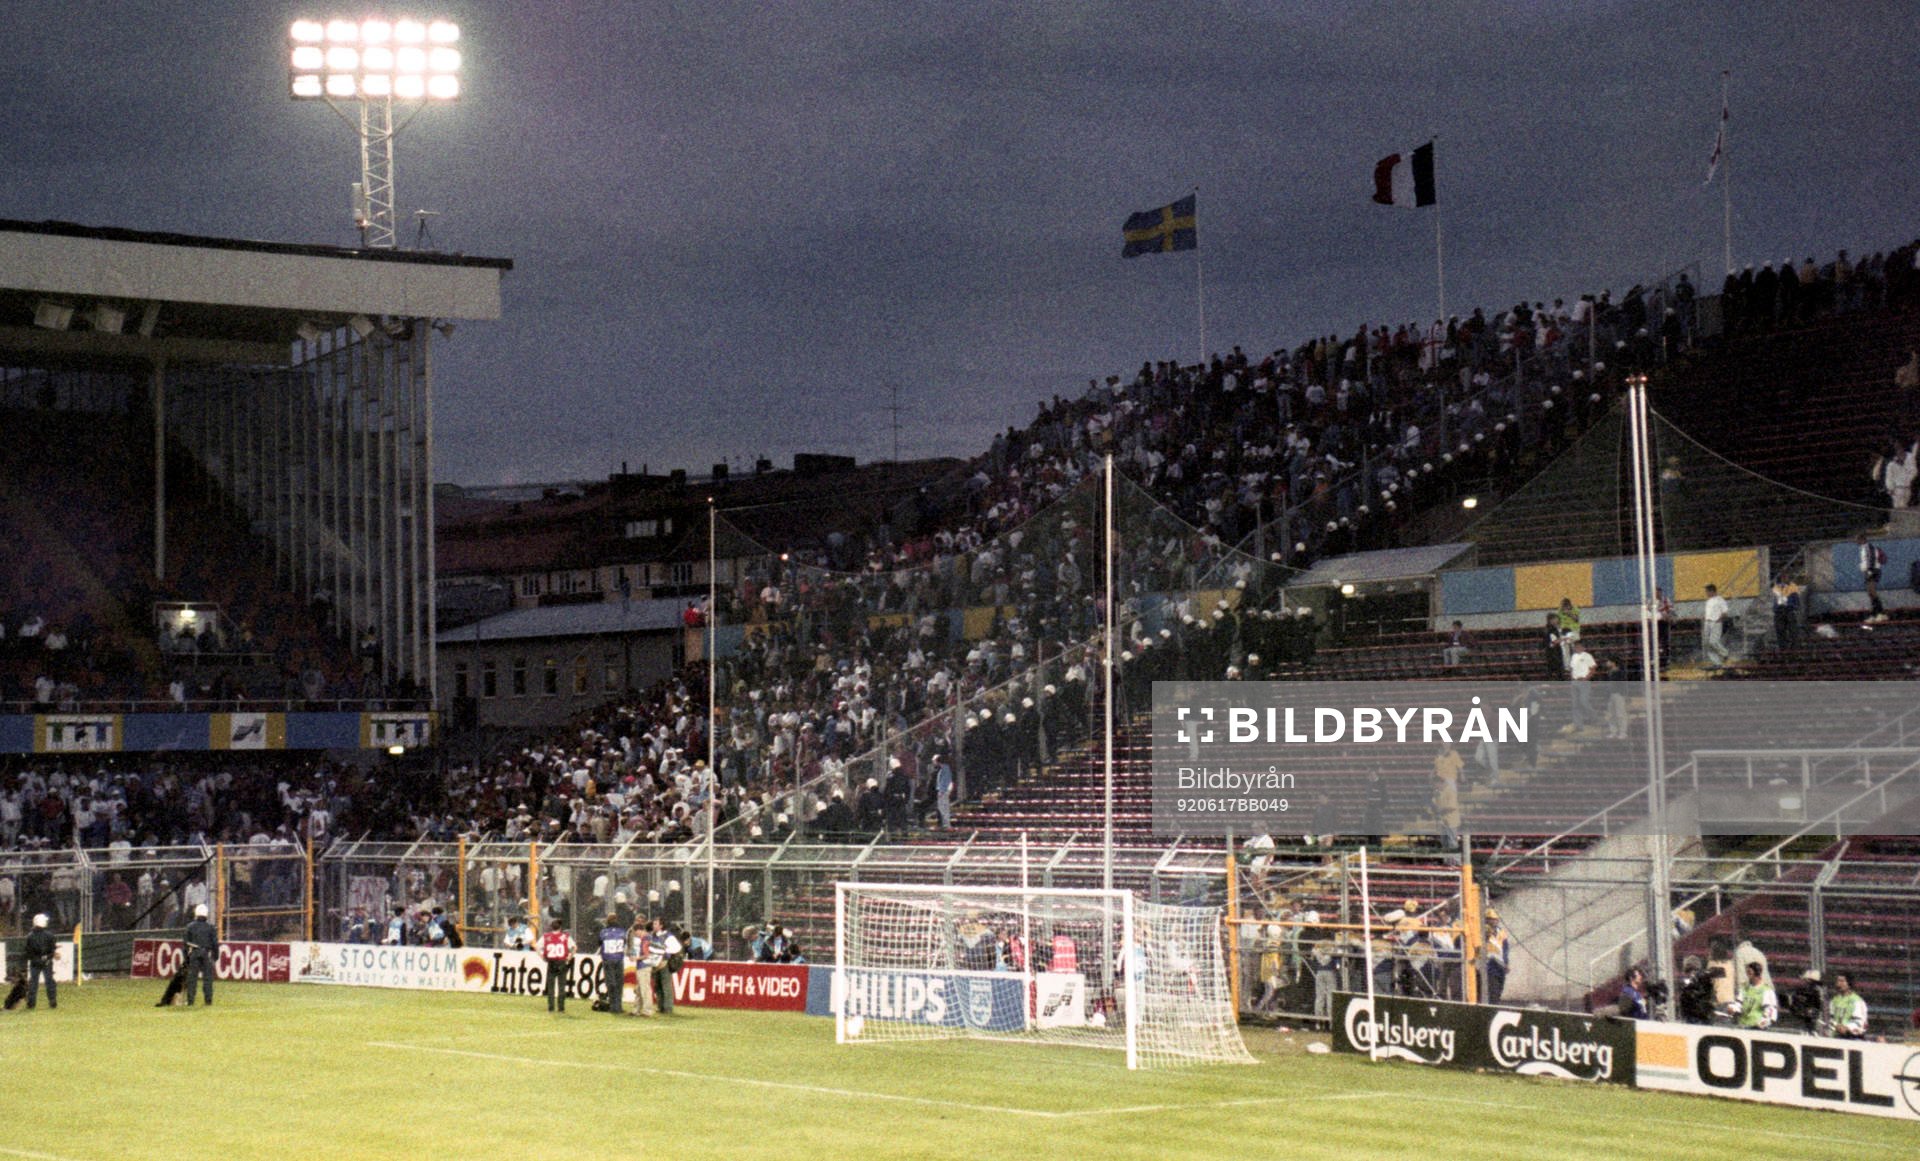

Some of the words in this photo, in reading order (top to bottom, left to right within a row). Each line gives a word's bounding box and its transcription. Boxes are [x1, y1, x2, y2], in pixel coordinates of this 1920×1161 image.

[157, 943, 263, 980] CoCola
[340, 948, 457, 974] STOCKHOLM
[546, 943, 566, 958] 20
[339, 971, 384, 983] BEAUTY
[392, 975, 408, 986] ON
[419, 976, 457, 988] WATER
[491, 952, 549, 996] Inte
[672, 967, 707, 1001] VC
[712, 974, 743, 995] HI-FI
[745, 976, 756, 995] &
[757, 976, 800, 998] VIDEO
[830, 972, 947, 1023] PHILIPS
[1345, 998, 1455, 1064] Carlsberg
[1489, 1010, 1613, 1081] Carlsberg
[1697, 1034, 1895, 1108] OPEL
